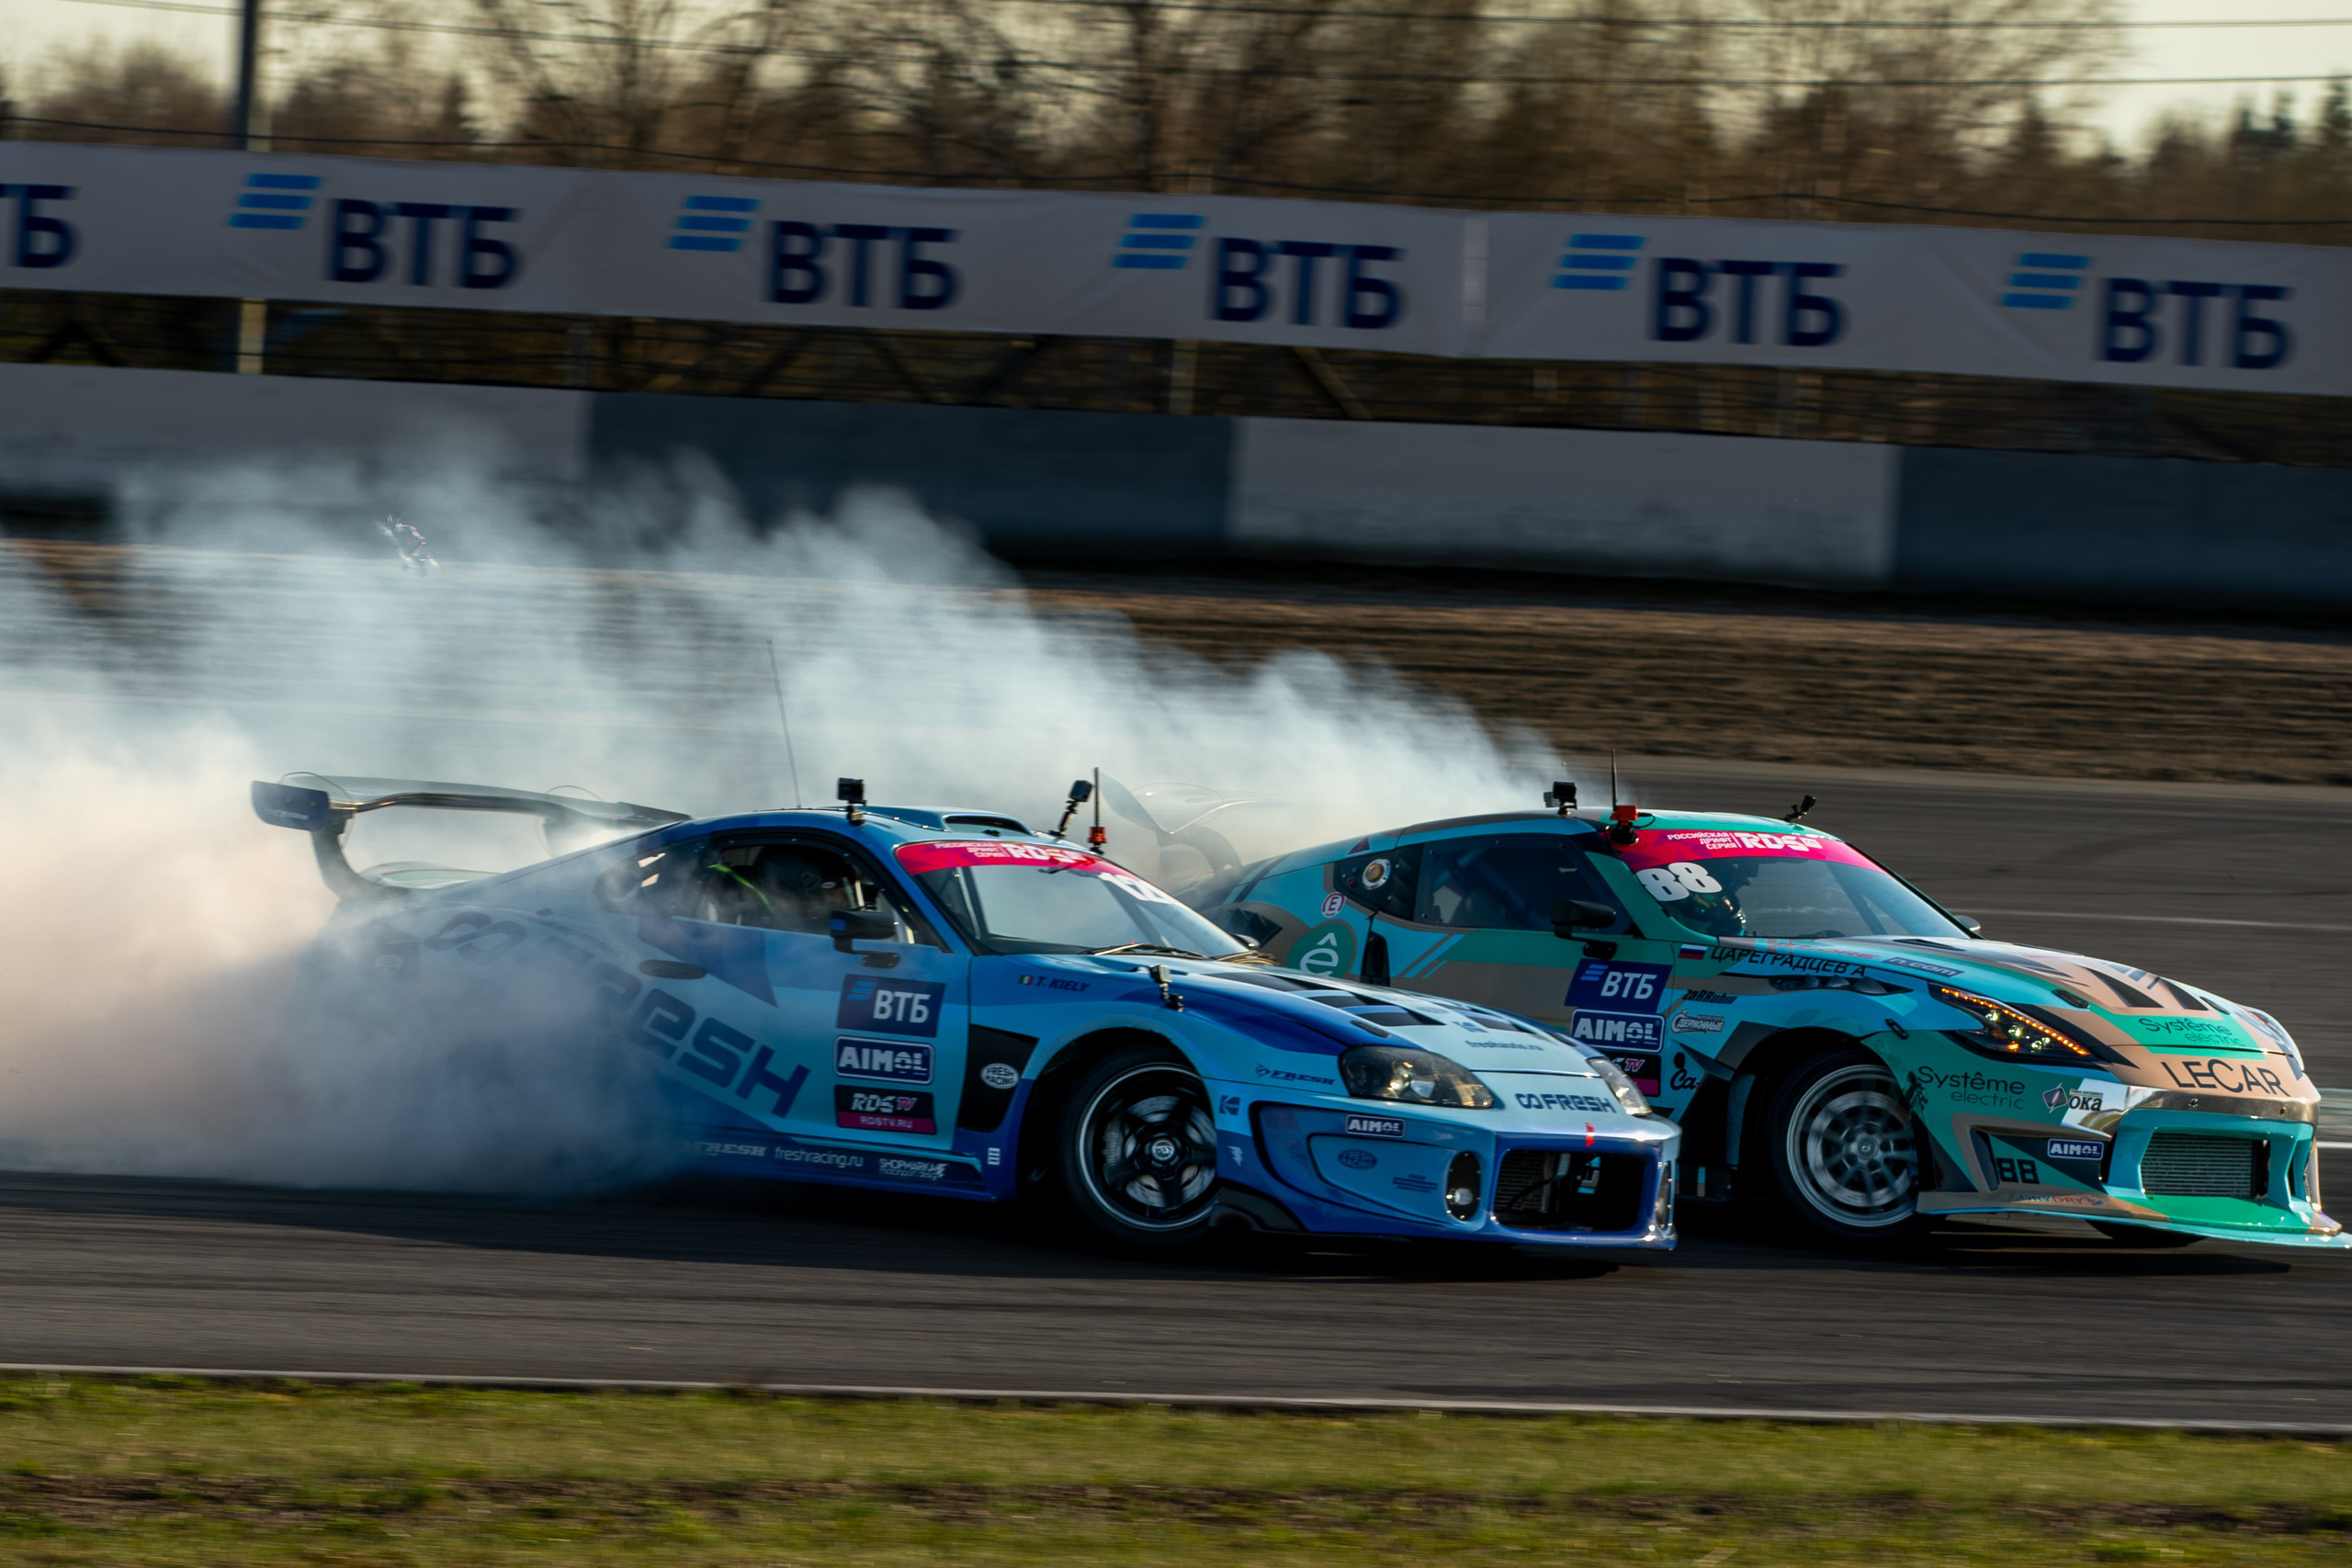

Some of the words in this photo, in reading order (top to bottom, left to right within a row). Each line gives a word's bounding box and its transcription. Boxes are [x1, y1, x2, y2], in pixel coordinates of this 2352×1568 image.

[328, 197, 524, 289] ВТБ
[765, 220, 961, 310] ВТБ
[1210, 237, 1404, 329] ВТБ
[1649, 256, 1847, 345] ВТБ
[2095, 277, 2294, 368] ВТБ
[1667, 831, 1730, 840] РОССИЙСКАЯ
[1700, 837, 1732, 845] ДРИФТ
[1735, 832, 1810, 852] RDS
[1635, 862, 1723, 902] 88
[1711, 946, 1852, 974] ЦАРЕГРАДЦЕВ
[1852, 965, 1866, 976] А
[1049, 978, 1091, 992] KIELY
[1600, 971, 1657, 999] ВТБ
[873, 989, 931, 1023] ВТБ
[1574, 1018, 1658, 1044] AIMOL
[2139, 1018, 2233, 1035] Système
[2185, 1031, 2245, 1047] electric
[839, 1046, 928, 1076] AIMOL
[1917, 1066, 2025, 1094] Système
[2161, 1059, 2290, 1097] LECAR
[1951, 1089, 2024, 1110] electric
[860, 1116, 912, 1128] RDSTV.RU
[1348, 1119, 1401, 1134] AIMOL
[775, 1146, 864, 1168] freshracing.ru
[2050, 1143, 2100, 1156] AIMOL
[1996, 1158, 2041, 1184] 88
